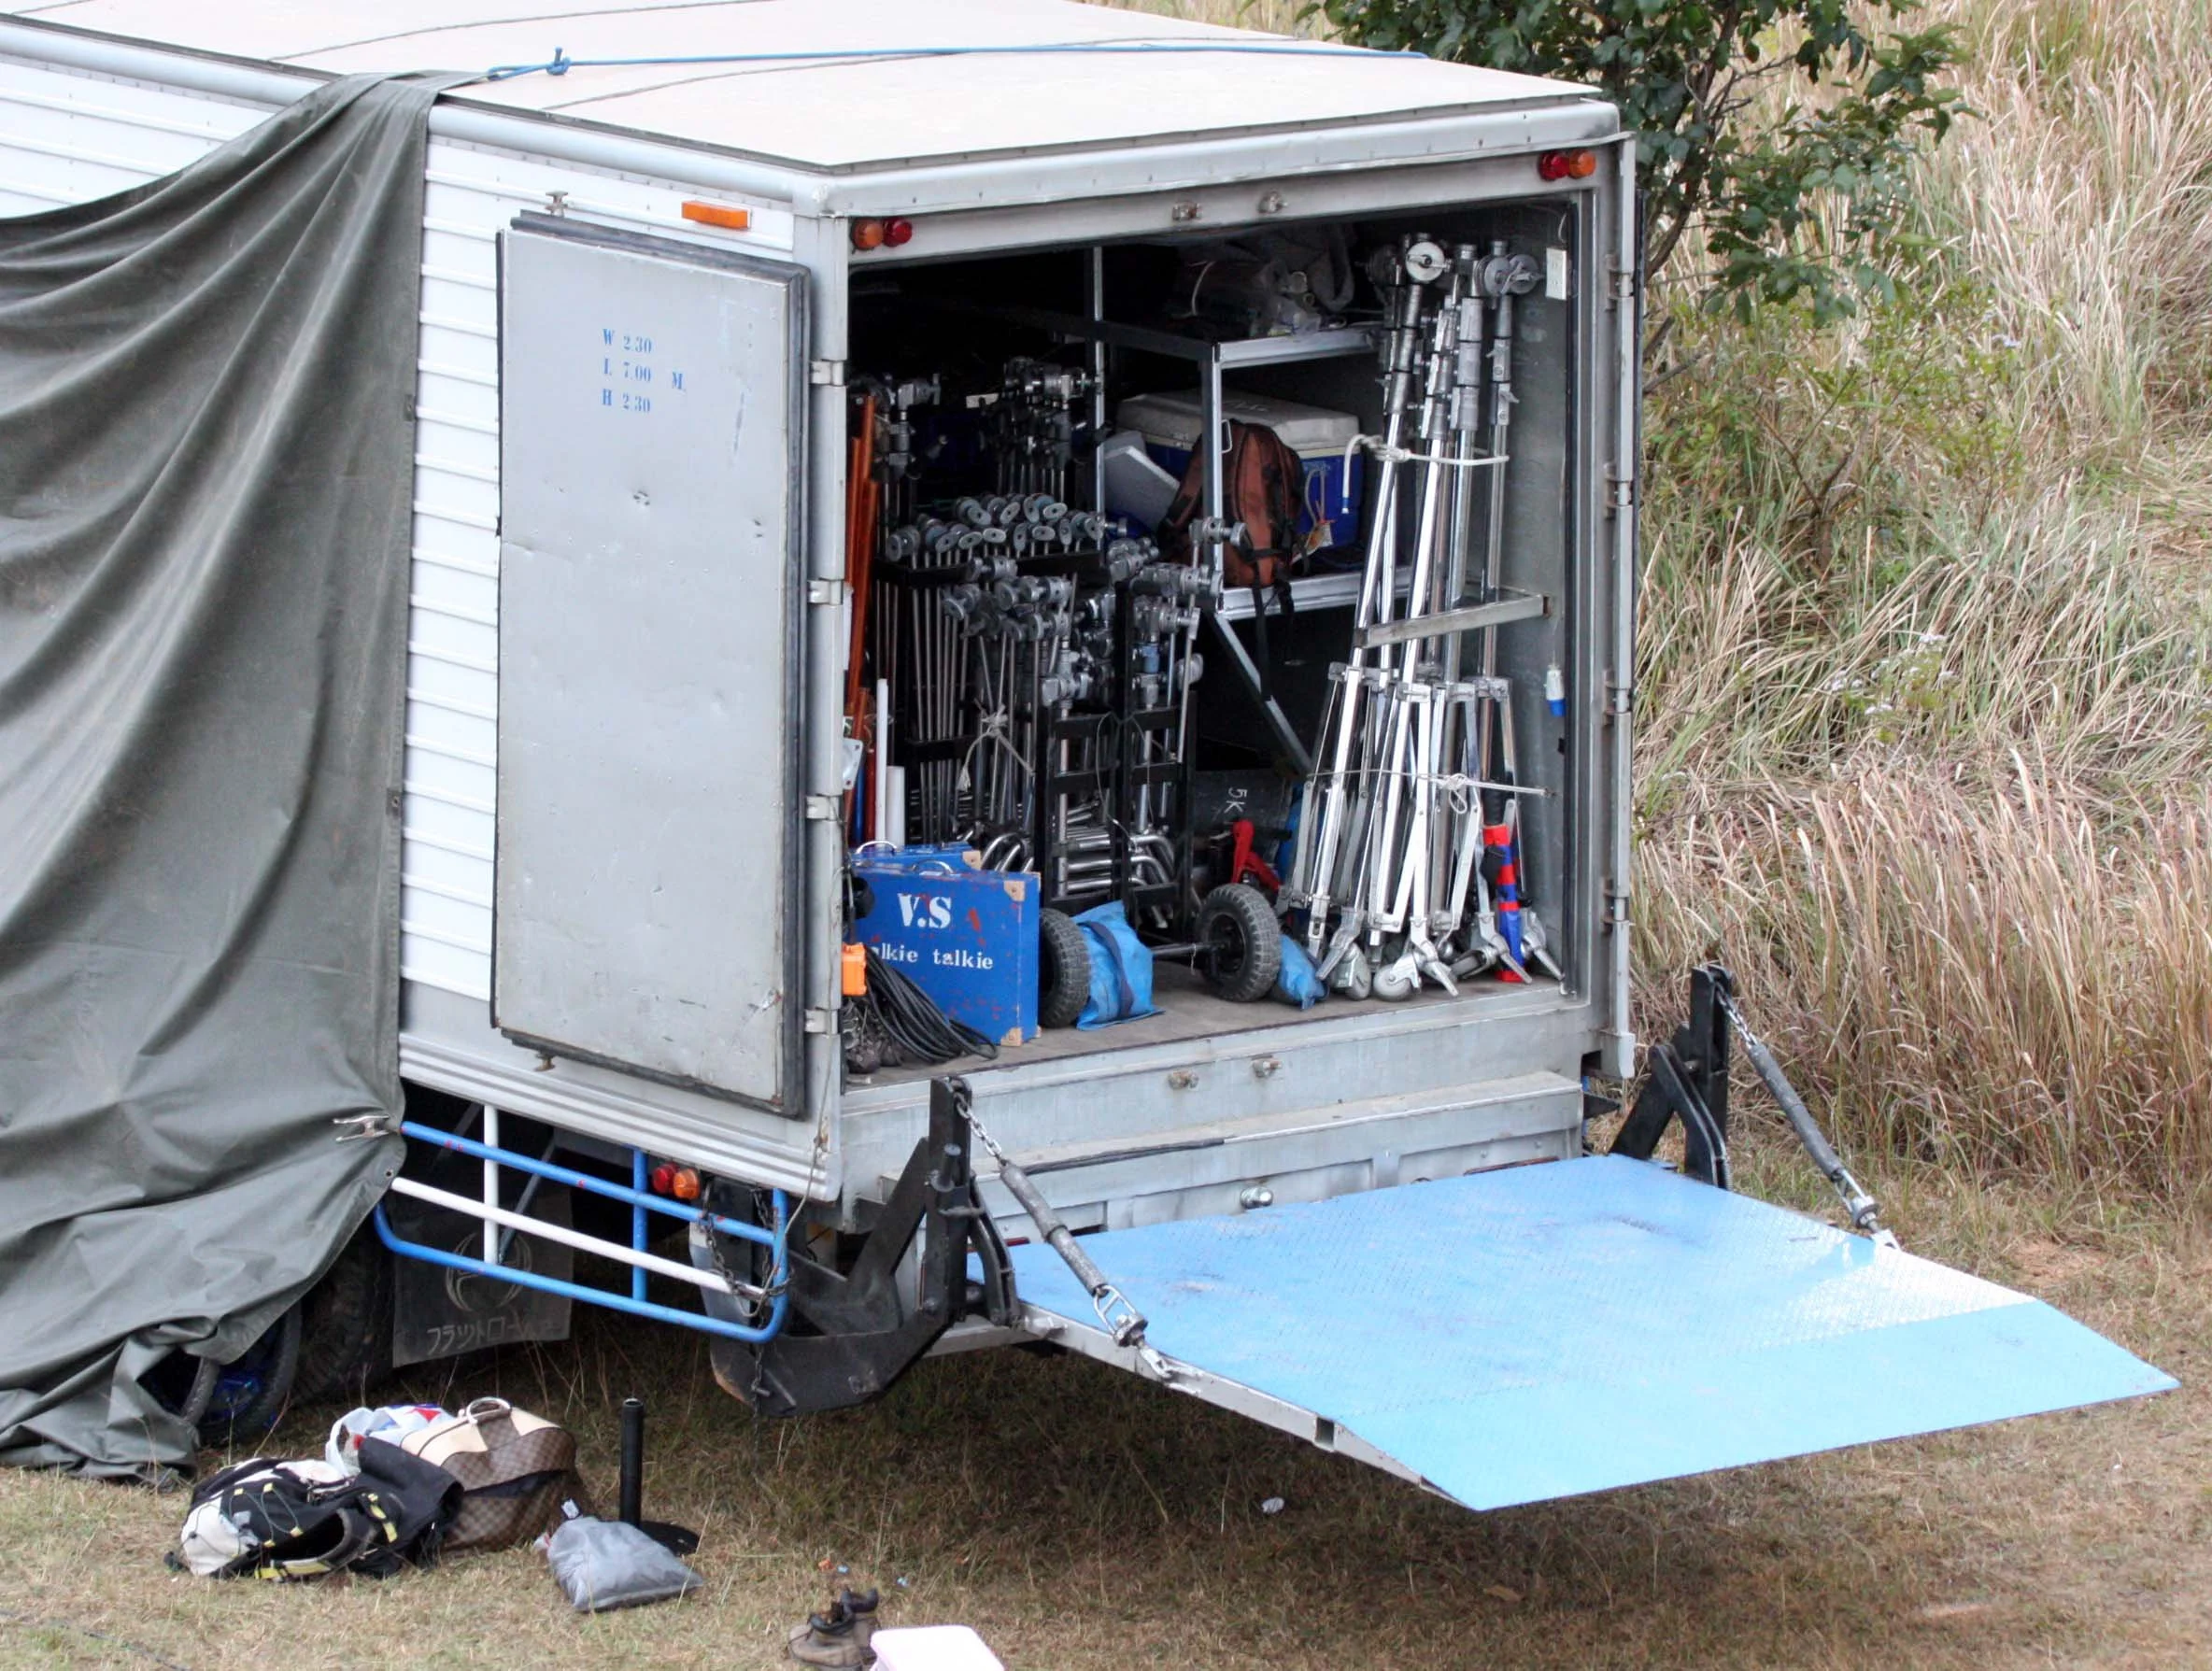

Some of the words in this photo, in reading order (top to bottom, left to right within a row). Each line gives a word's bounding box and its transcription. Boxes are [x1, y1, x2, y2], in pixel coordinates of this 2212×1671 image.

[603, 328, 615, 346] W
[623, 335, 652, 353] 2.30
[623, 361, 651, 383] 7.00
[603, 388, 612, 405] H
[622, 392, 651, 412] 2.30
[1225, 787, 1248, 814] 5K
[897, 894, 952, 929] V.S
[933, 949, 993, 970] talkie
